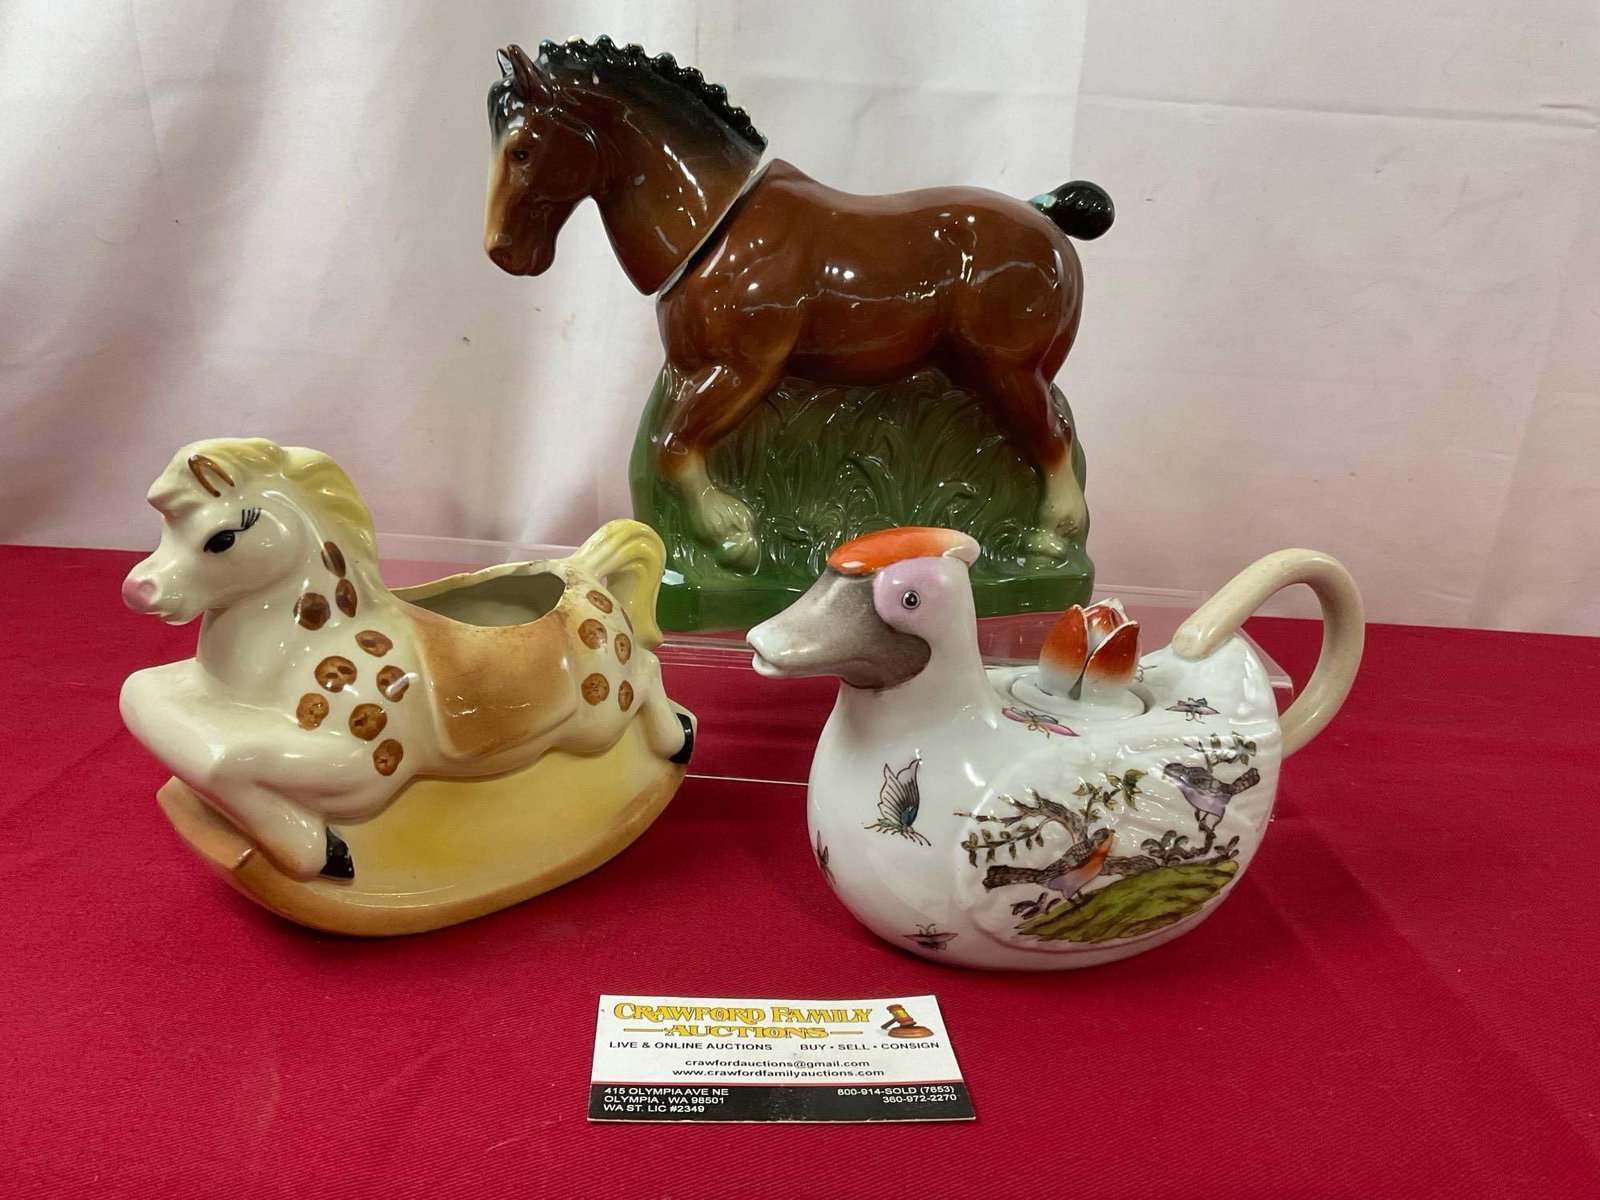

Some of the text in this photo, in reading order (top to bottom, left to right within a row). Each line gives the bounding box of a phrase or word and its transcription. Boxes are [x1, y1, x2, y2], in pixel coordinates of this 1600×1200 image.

[614, 1003, 872, 1024] CRAWFORD FAMILY
[665, 1025, 829, 1039] AUCTIONS
[609, 1041, 638, 1049] LIVE
[654, 1042, 703, 1050] ONLINE
[706, 1043, 773, 1051] AUCTIONS
[881, 1042, 940, 1050] CONSIGN
[685, 1059, 870, 1068] crawfordauctions@gmail.com
[672, 1069, 885, 1078] www.crawfordfamilyauctions.com
[628, 1088, 685, 1096] OLYMPIA
[685, 1088, 709, 1096] AVE
[712, 1088, 729, 1096] NE
[837, 1087, 917, 1096] 800-914-SOLD
[691, 1097, 724, 1105] 98501
[882, 1094, 957, 1104] 360-972-2270
[626, 1104, 644, 1112] ST.
[670, 1105, 705, 1113] #2349
